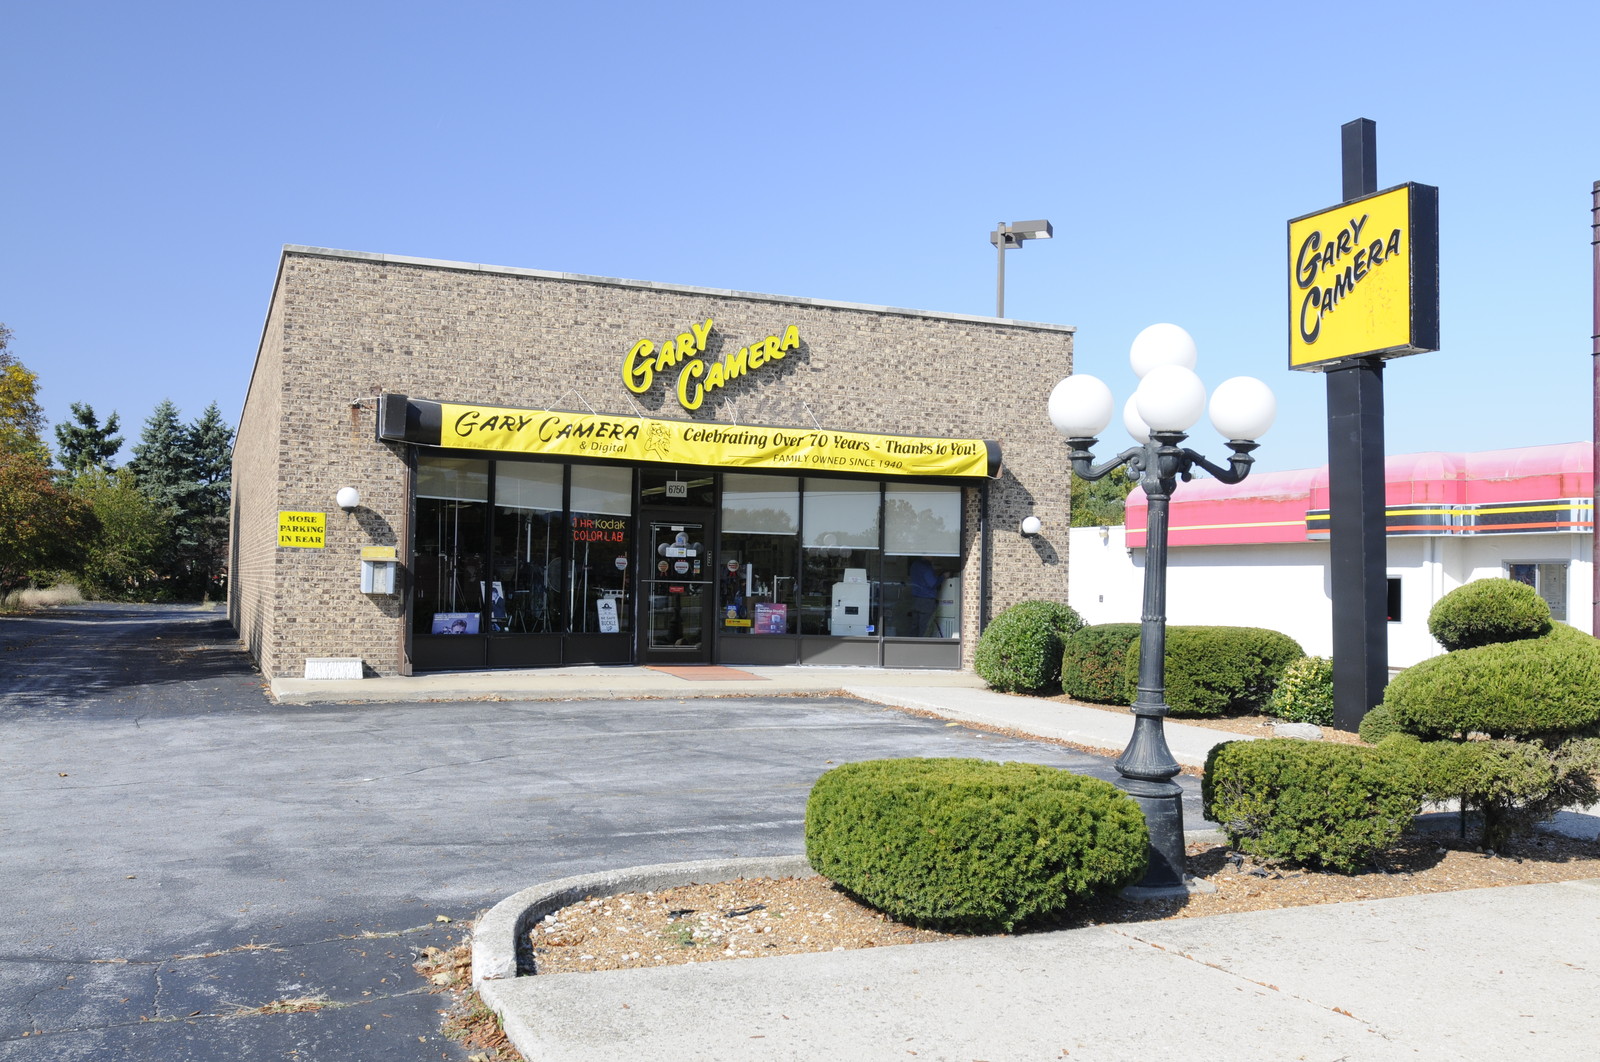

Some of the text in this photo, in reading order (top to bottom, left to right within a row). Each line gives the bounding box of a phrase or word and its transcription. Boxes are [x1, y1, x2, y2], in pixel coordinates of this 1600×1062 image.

[1296, 213, 1369, 288] GARY
[1300, 228, 1402, 344] CAMERA
[622, 318, 713, 394] GARY
[677, 325, 800, 410] CAMERA
[454, 410, 640, 443] GARY CAMERA
[579, 441, 628, 454] & Digital
[683, 427, 768, 449] Celebrating
[773, 432, 804, 447] Over
[810, 434, 828, 448] 70
[834, 435, 870, 451] Years
[885, 440, 933, 455] Thanks
[936, 443, 947, 455] to
[950, 442, 977, 456] You!
[773, 454, 903, 469] FAMILY OWNED SINCE 1940
[668, 484, 685, 494] 6750
[287, 515, 317, 523] MORE
[580, 519, 593, 528] HR
[595, 519, 625, 530] Kodak
[280, 525, 324, 533] PARKING
[573, 530, 624, 542] COLOR LAB
